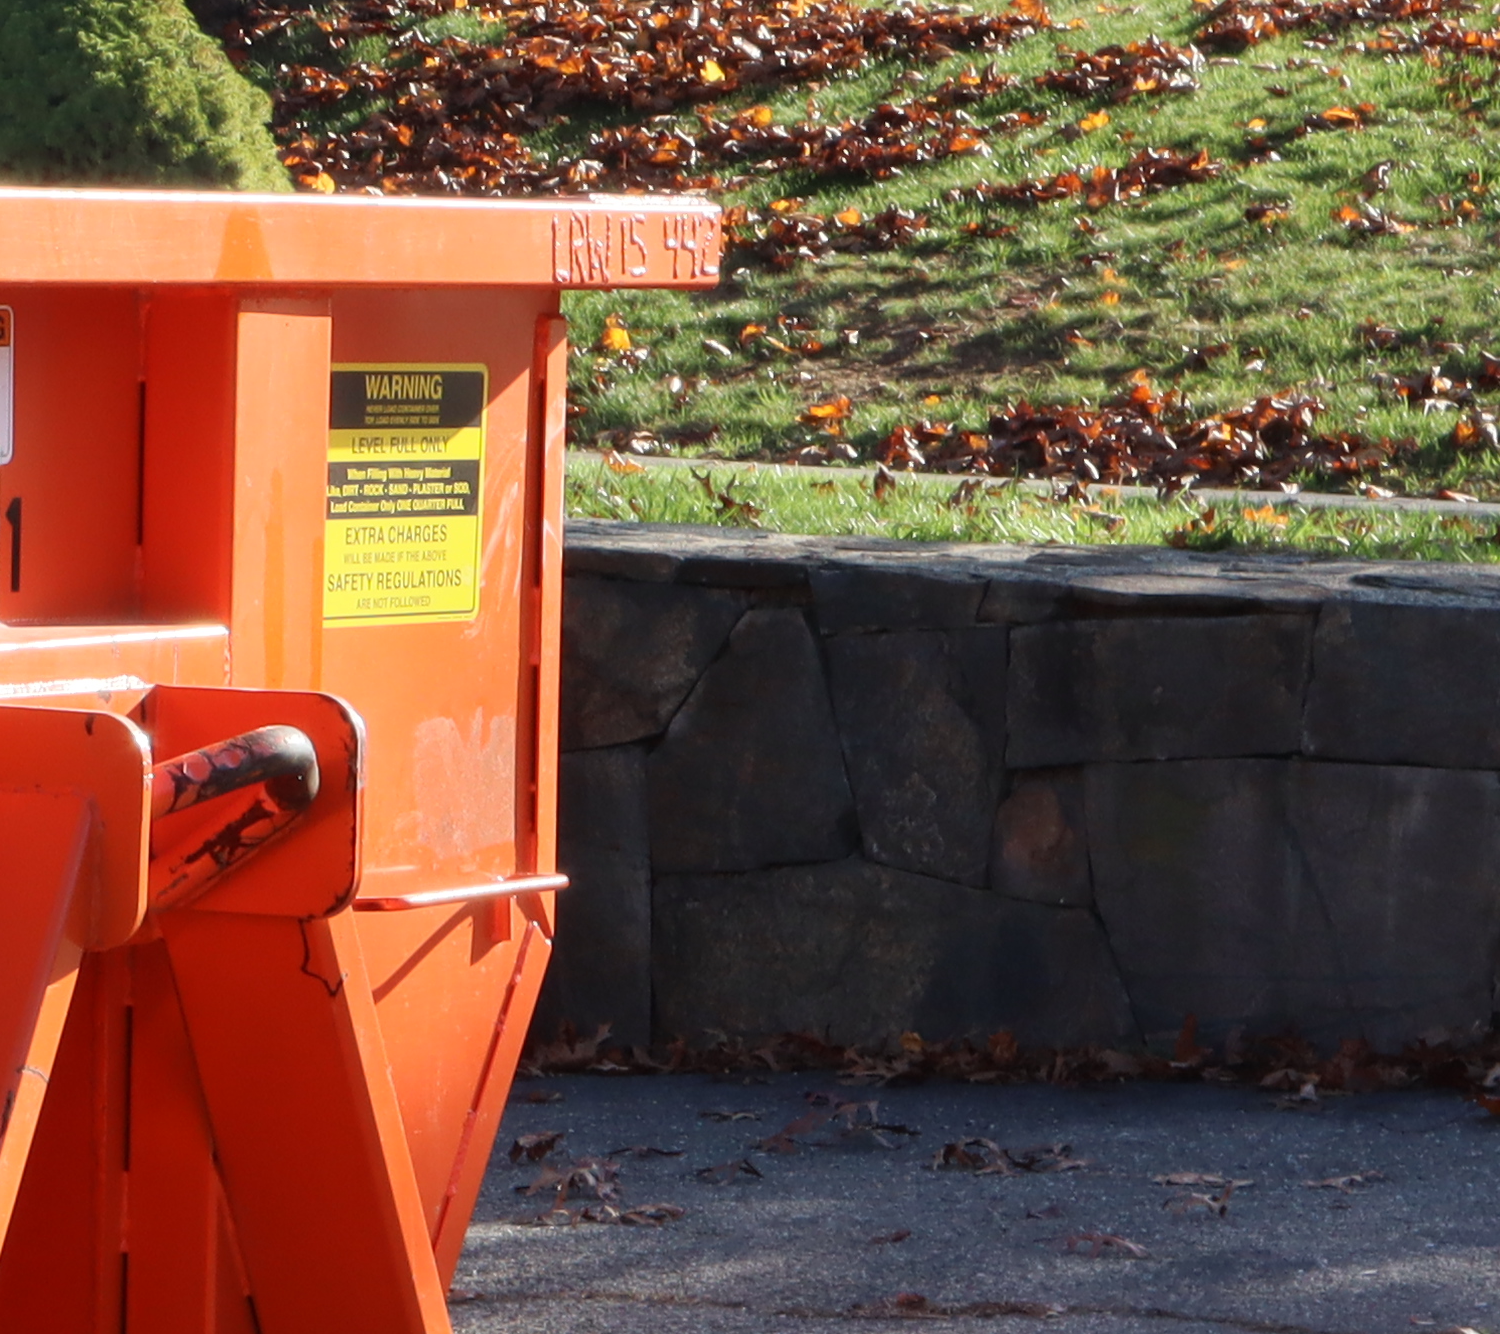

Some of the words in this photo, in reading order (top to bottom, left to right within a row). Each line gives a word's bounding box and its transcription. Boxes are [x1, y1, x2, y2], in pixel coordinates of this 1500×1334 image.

[365, 374, 442, 400] WARNING
[352, 436, 386, 455] LEVEL
[390, 436, 416, 454] FULL
[420, 435, 449, 453] ONLY
[346, 526, 385, 545] EXTRA
[388, 524, 447, 544] CHARGES
[344, 553, 360, 564] WILL
[363, 552, 372, 564] BE
[375, 551, 395, 563] MADE
[406, 550, 420, 562] THE
[422, 549, 447, 561] ABOVE
[327, 572, 373, 592] SAFETY
[376, 569, 461, 590] REGULATIONS
[356, 598, 371, 609] ARE
[373, 597, 388, 609] NOT
[390, 596, 431, 608] FOLLOWED
